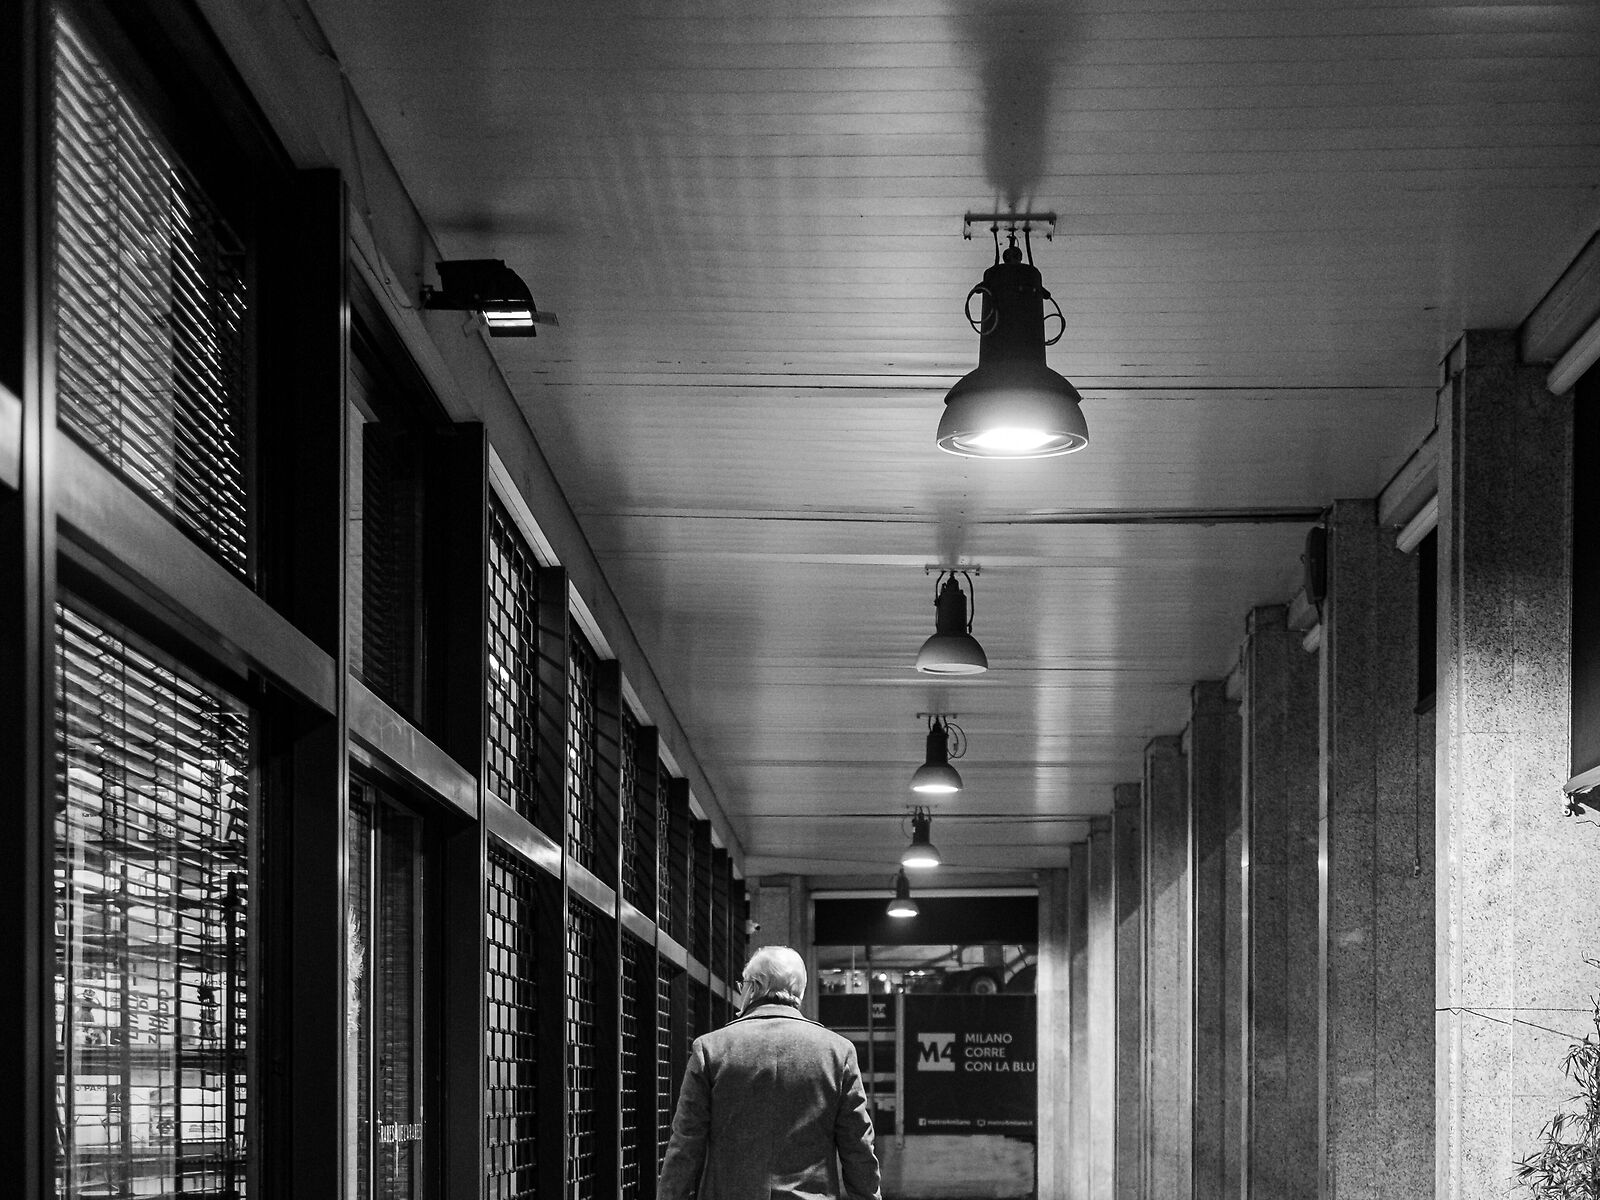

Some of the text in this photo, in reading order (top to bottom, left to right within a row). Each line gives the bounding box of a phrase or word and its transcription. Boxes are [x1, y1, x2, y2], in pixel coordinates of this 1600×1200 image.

[965, 1033, 1013, 1044] MILANO
[965, 1047, 1006, 1058] CORRE
[965, 1061, 1035, 1072] CON LA BLU
